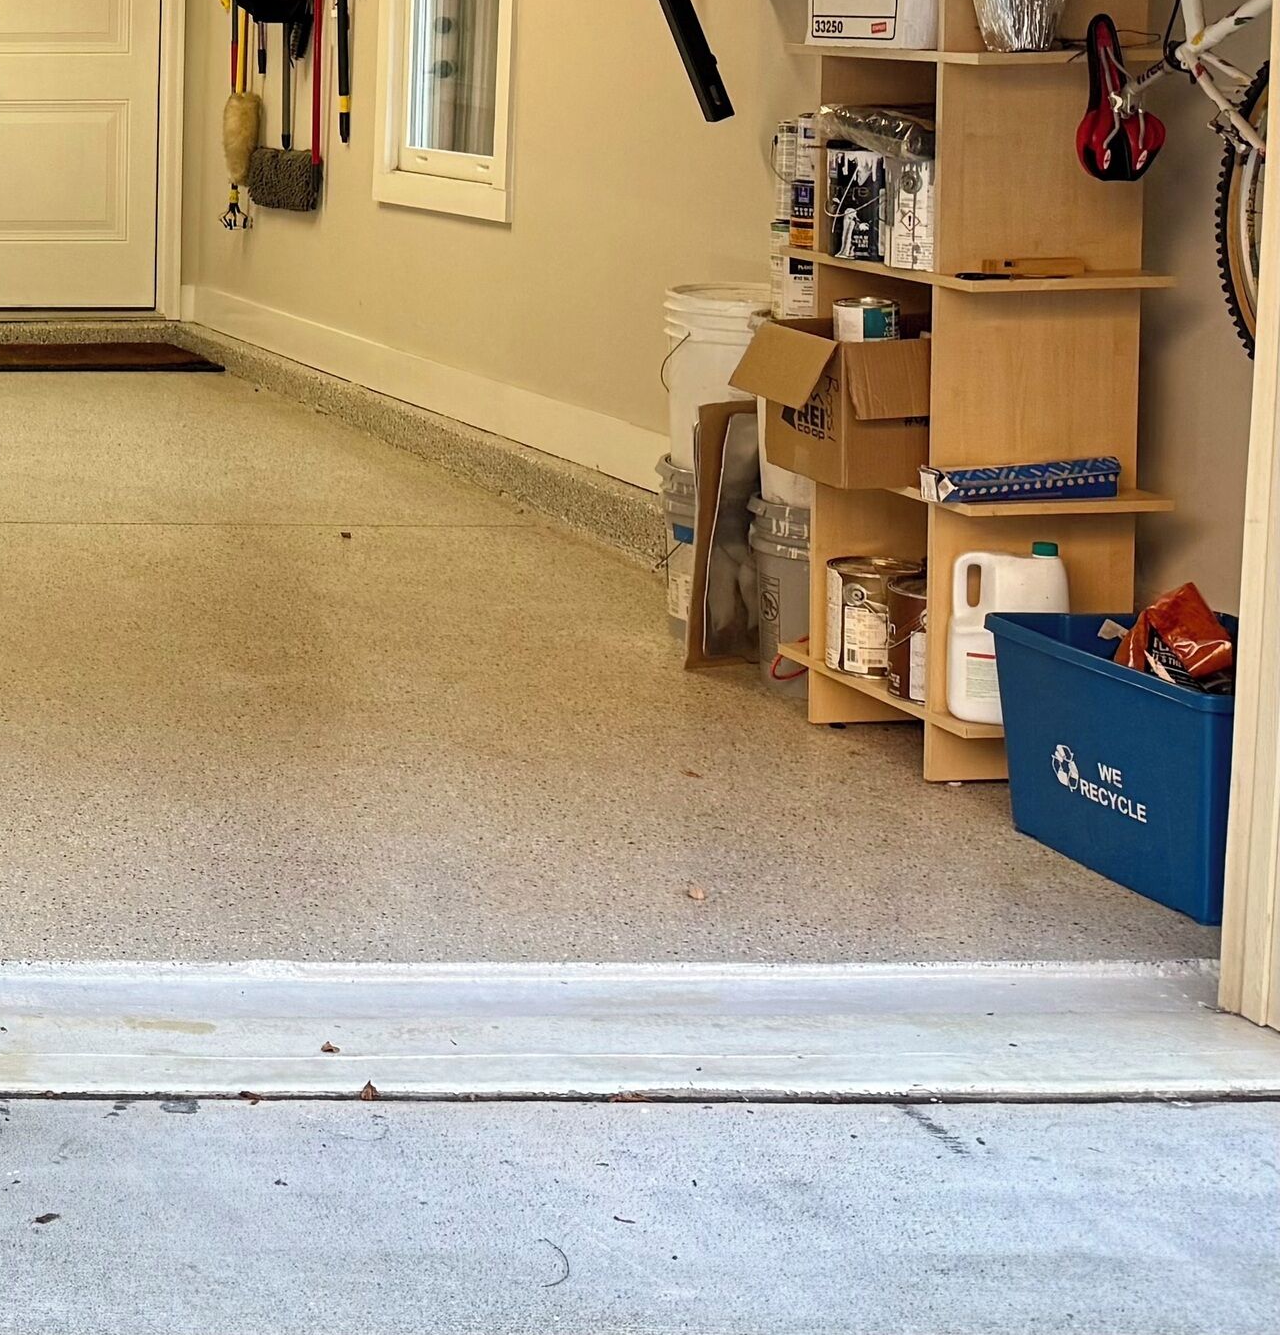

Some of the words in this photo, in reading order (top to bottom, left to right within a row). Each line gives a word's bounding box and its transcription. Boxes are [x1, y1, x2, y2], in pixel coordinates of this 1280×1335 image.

[815, 20, 844, 34] 33250
[798, 403, 826, 430] REI
[1097, 761, 1123, 789] WE
[1079, 777, 1148, 824] RECYCLE
